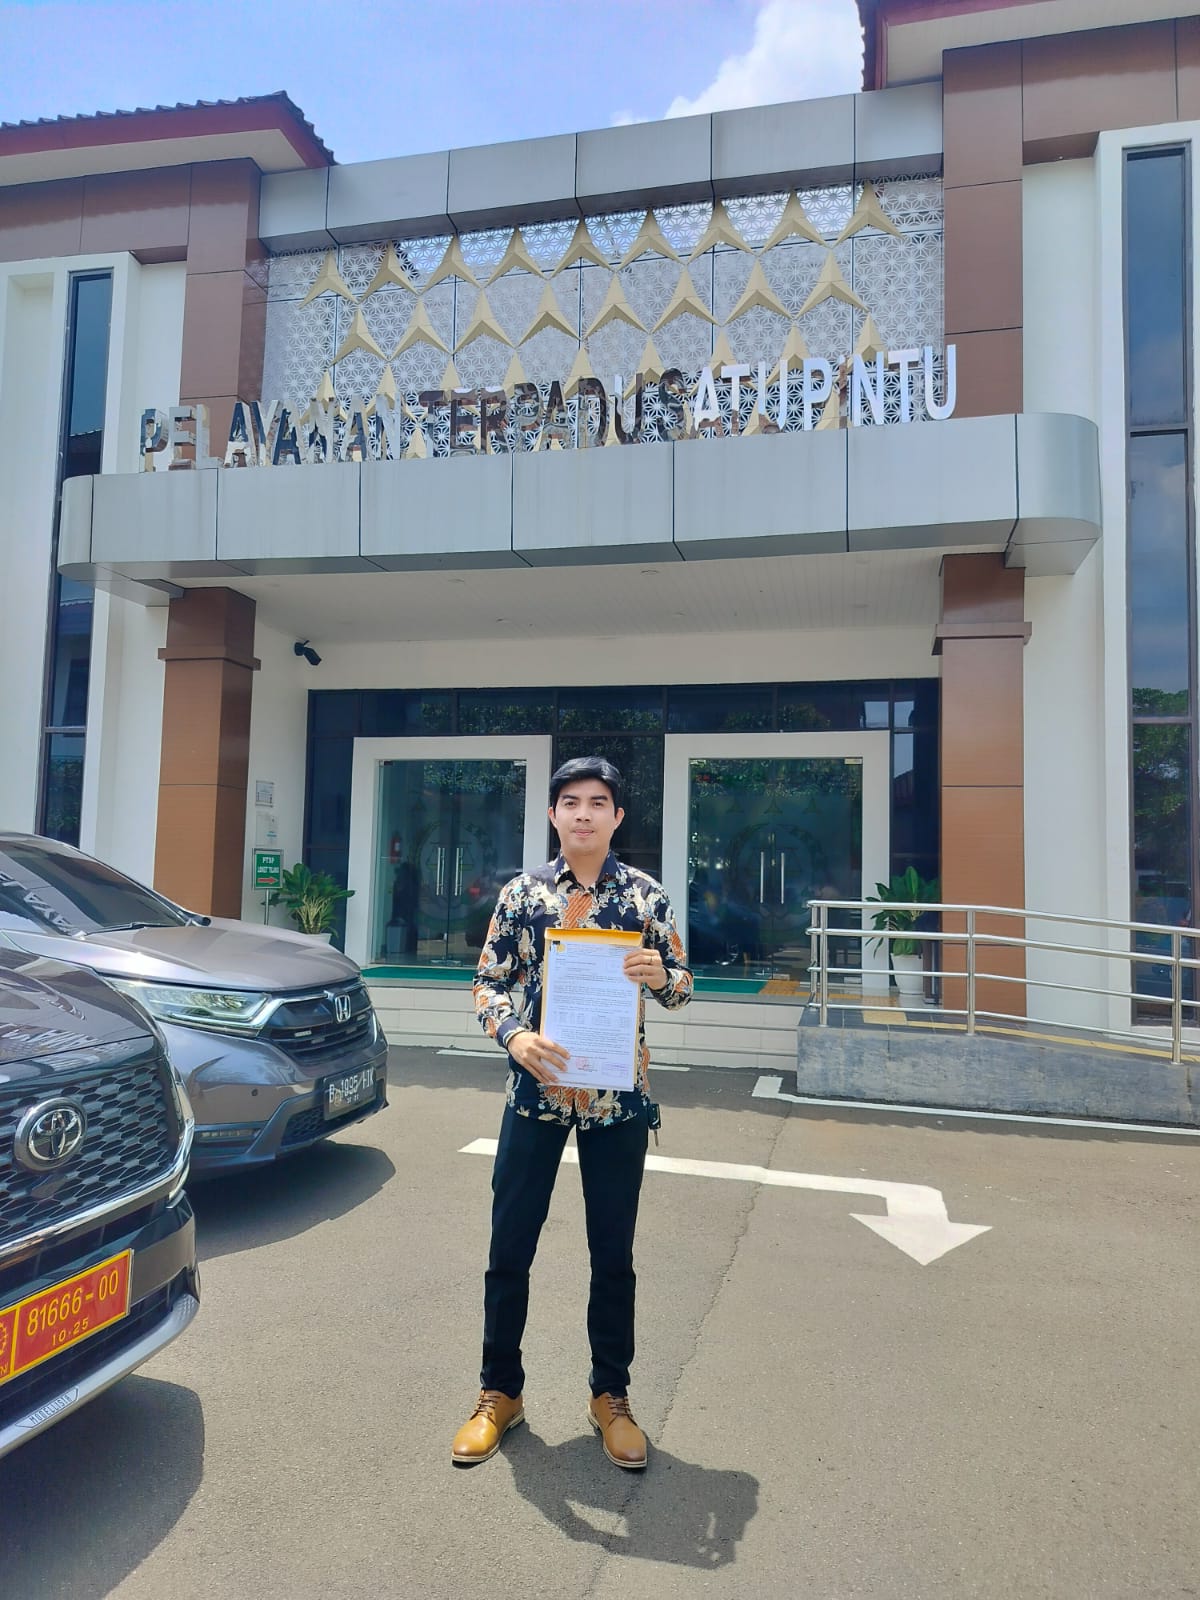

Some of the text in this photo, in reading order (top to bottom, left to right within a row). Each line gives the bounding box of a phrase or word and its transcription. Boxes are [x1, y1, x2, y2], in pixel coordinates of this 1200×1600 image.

[140, 344, 957, 473] PELAYANAN TERPADU SATU PINTU
[329, 1084, 335, 1103] B
[26, 1269, 119, 1337] 81666-00
[29, 1395, 72, 1425] MODELLISTA
